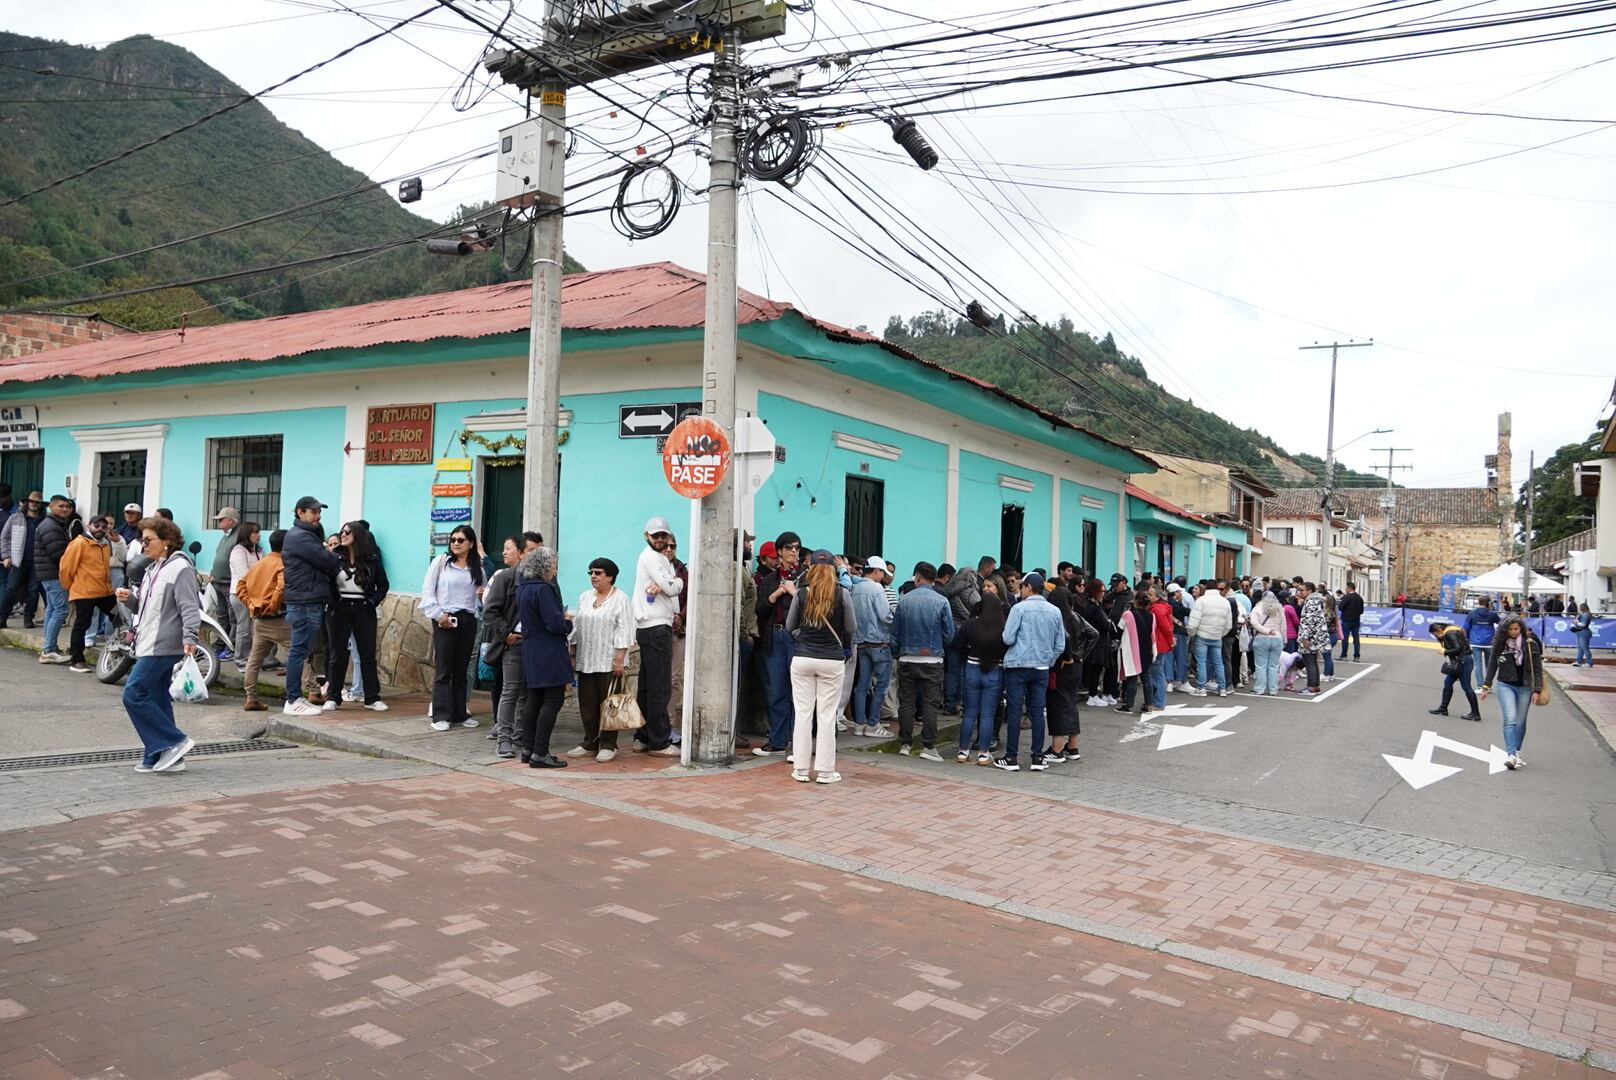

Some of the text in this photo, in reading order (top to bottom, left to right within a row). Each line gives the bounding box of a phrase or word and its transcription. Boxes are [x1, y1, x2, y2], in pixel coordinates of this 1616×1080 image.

[368, 408, 430, 424] SANTUARIO
[368, 427, 423, 443] DEL SEÑOR
[687, 434, 711, 453] NO
[367, 448, 380, 461] DE
[394, 447, 430, 462] PIEDRA
[671, 465, 715, 485] PASE
